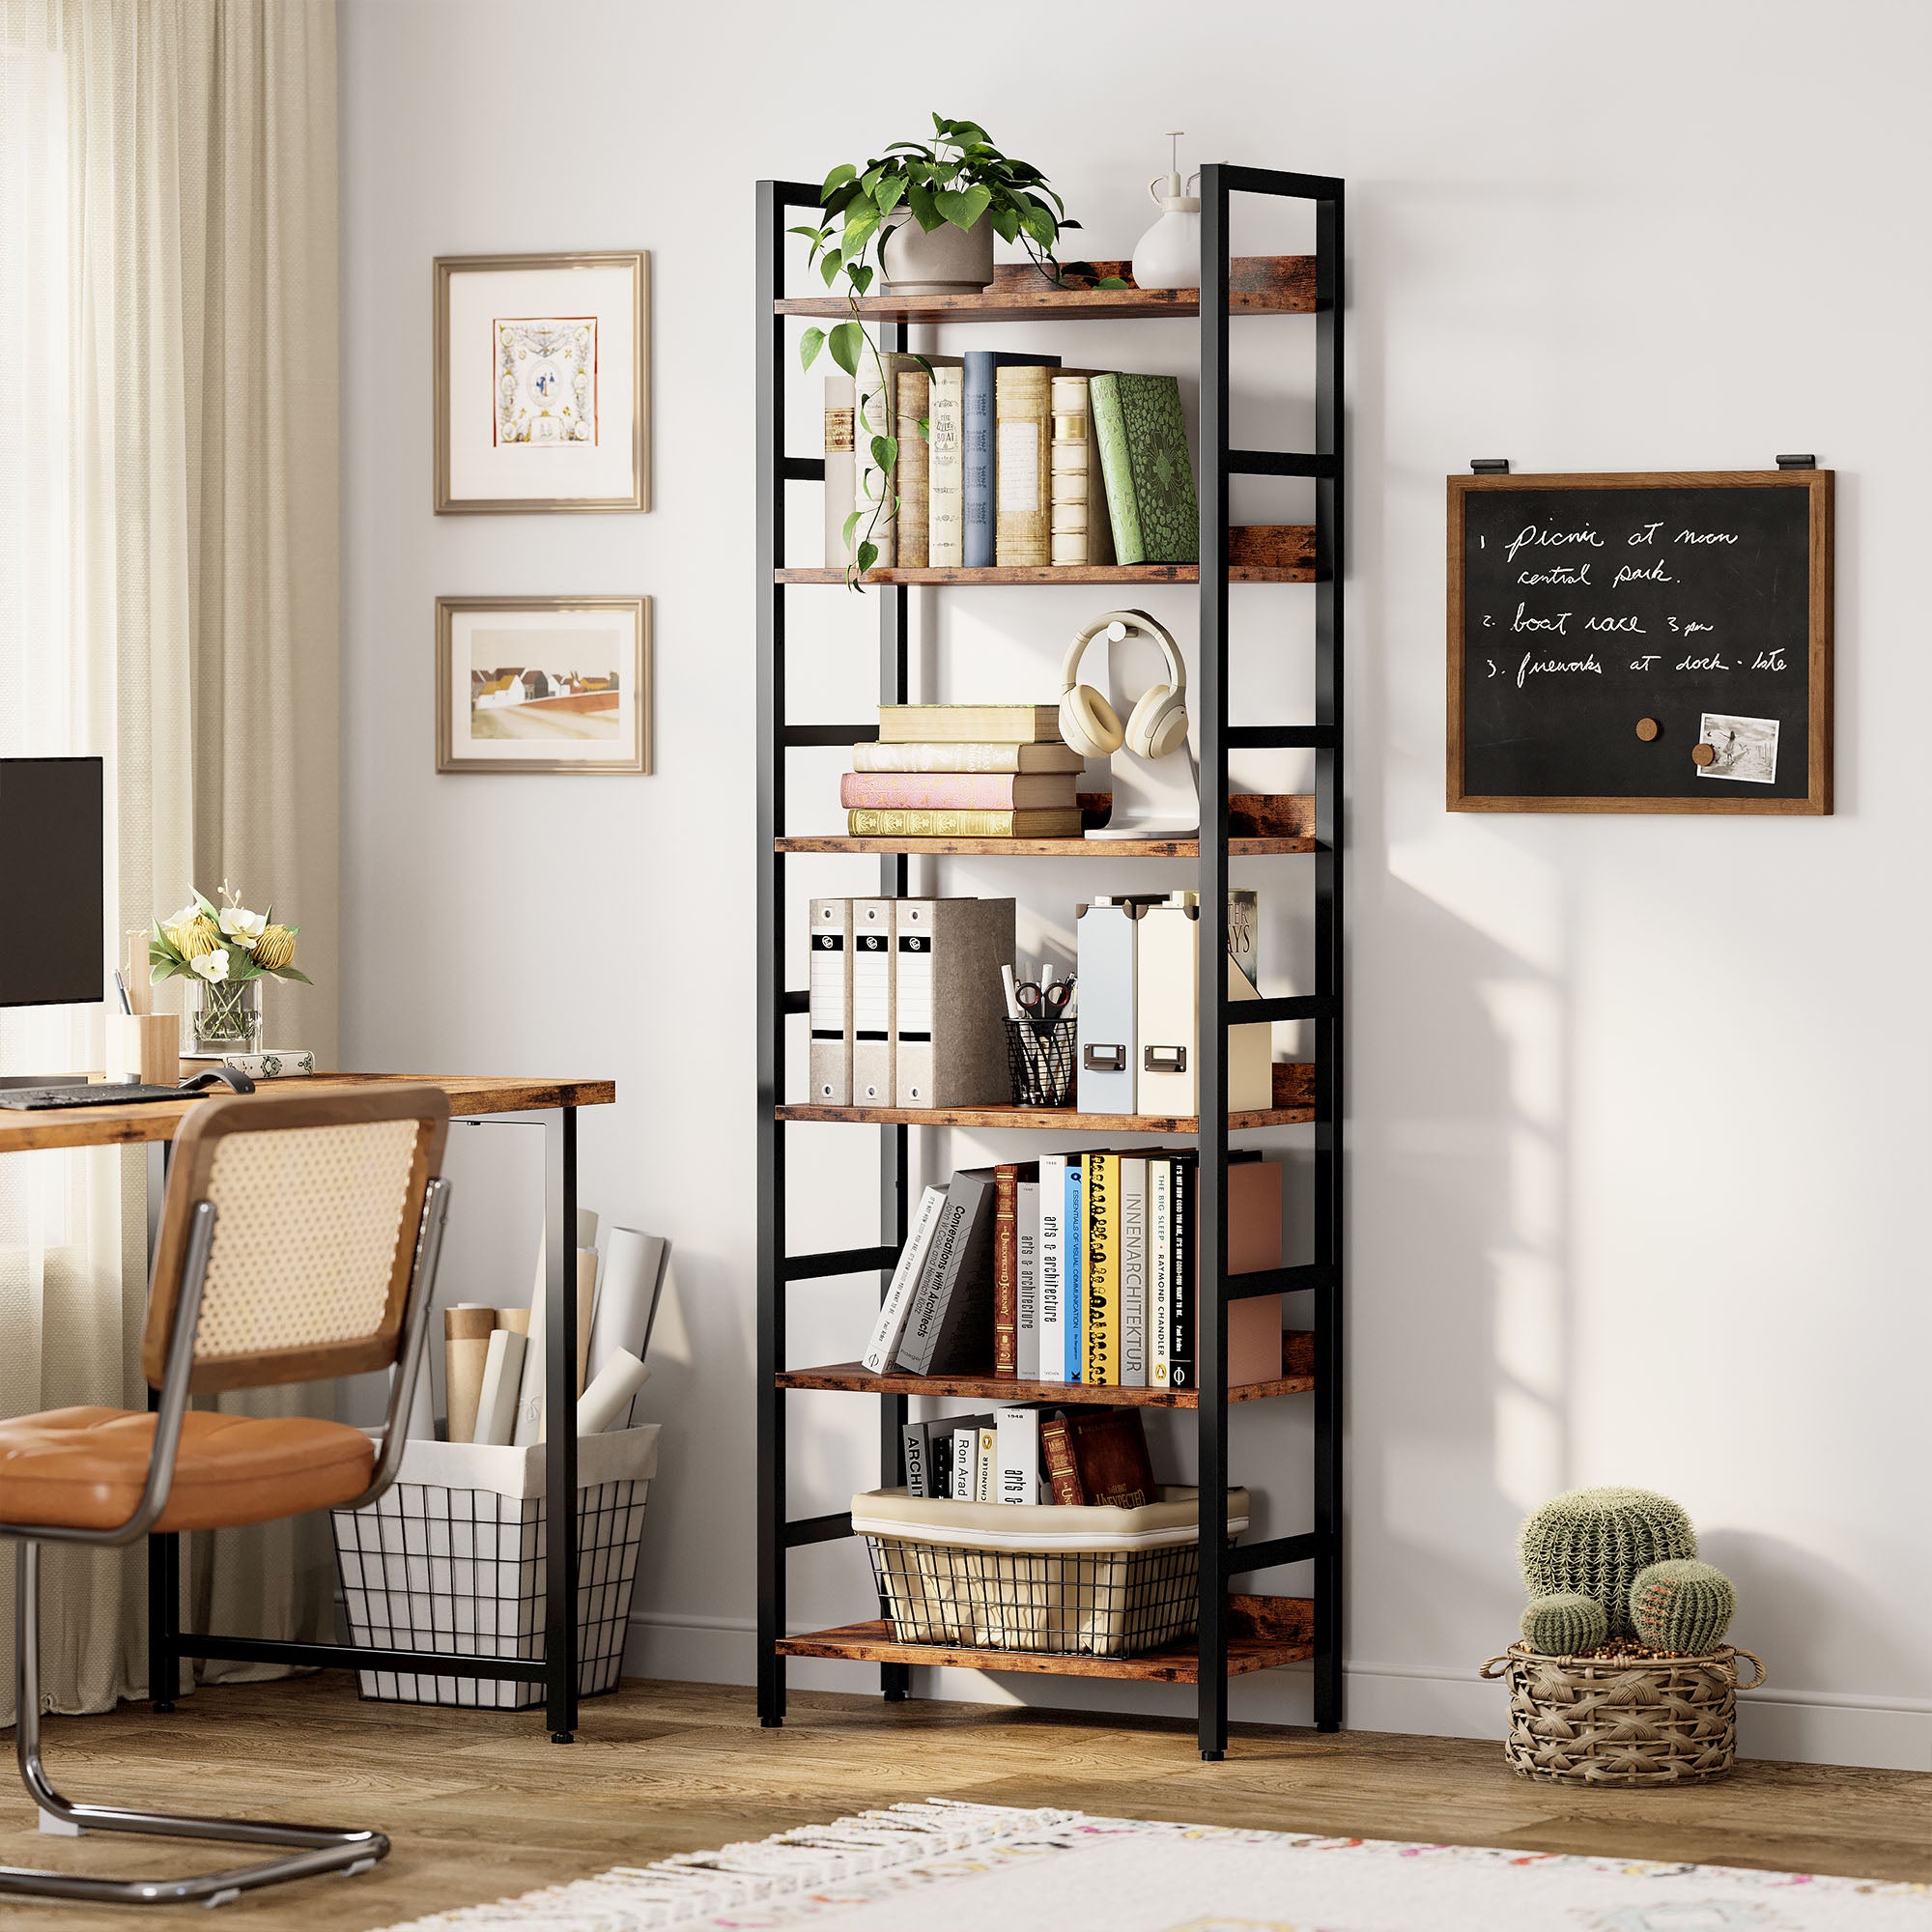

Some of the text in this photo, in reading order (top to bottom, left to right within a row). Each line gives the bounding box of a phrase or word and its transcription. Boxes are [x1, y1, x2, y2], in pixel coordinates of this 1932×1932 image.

[1505, 518, 1604, 562] picnic
[1628, 523, 1663, 547] at
[1674, 526, 1739, 545] noon
[1518, 564, 1591, 585] central
[1511, 602, 1572, 635] boat
[1585, 615, 1646, 634] race
[1517, 651, 1602, 688] fireworks
[1630, 656, 1661, 671] at
[1676, 654, 1729, 671] dock
[1751, 648, 1787, 672] late
[941, 1202, 954, 1221] John
[1044, 1216, 1059, 1237] arts
[1021, 1236, 1035, 1255] arts
[1072, 1232, 1079, 1242] OF
[917, 1206, 966, 1338] Conversations with Architects
[929, 1250, 939, 1267] and
[920, 1265, 936, 1296] Heinrich
[1044, 1256, 1060, 1322] architecture
[1126, 1193, 1142, 1372] INNENARCHITEKTUR
[914, 1296, 926, 1315] Klotz
[1021, 1270, 1036, 1329] architecture
[957, 1439, 970, 1496] Ron Arad
[980, 1457, 989, 1501] CHANDLER
[1005, 1469, 1027, 1492] arts
